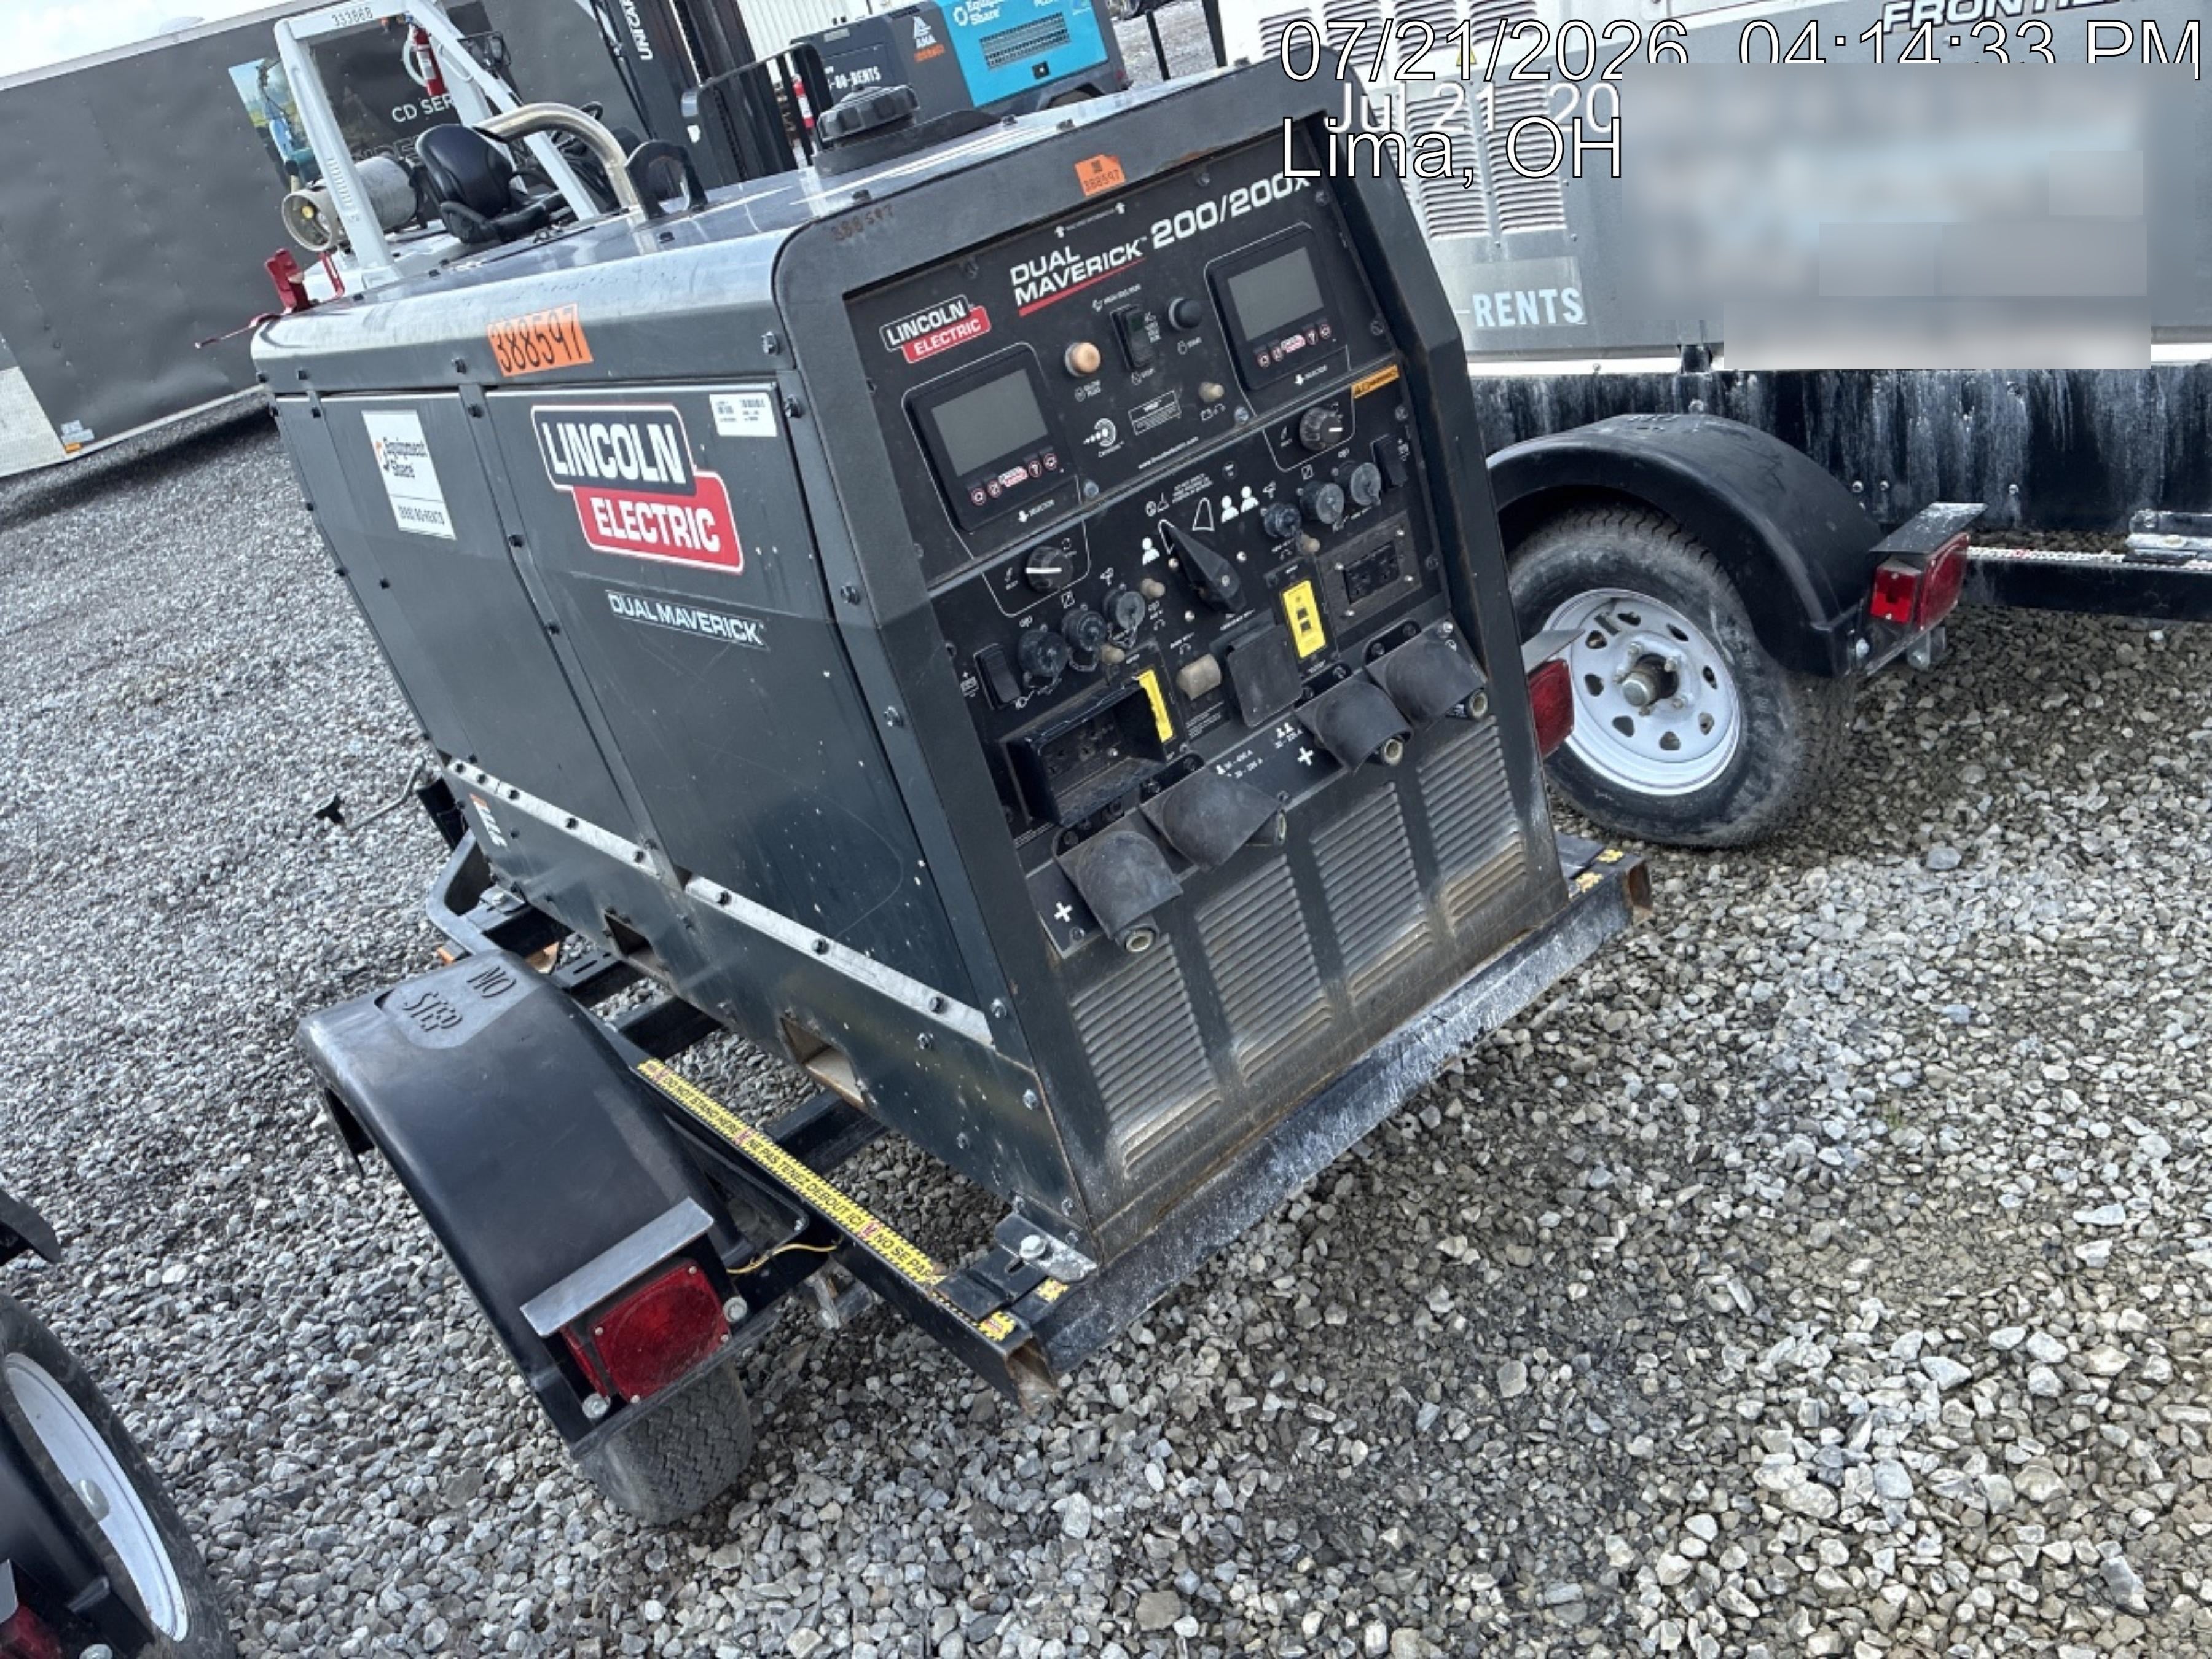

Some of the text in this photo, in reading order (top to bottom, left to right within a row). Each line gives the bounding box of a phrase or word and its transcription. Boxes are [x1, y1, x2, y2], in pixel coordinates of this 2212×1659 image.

[392, 104, 417, 122] CD
[1010, 245, 1081, 286] DUAL
[492, 310, 583, 372] 388597
[886, 299, 967, 345] LINCOLN
[914, 318, 982, 356] ELECTRIC
[541, 422, 686, 484] LINCOLN
[590, 496, 721, 552] ELECTRIC
[607, 594, 657, 622] DUAL
[466, 965, 517, 998] NO
[402, 990, 464, 1033] STEP
[760, 1148, 781, 1164] PAS
[807, 1182, 852, 1215] DEBOUT
[874, 1233, 895, 1249] NO
[891, 1246, 911, 1262] SE
